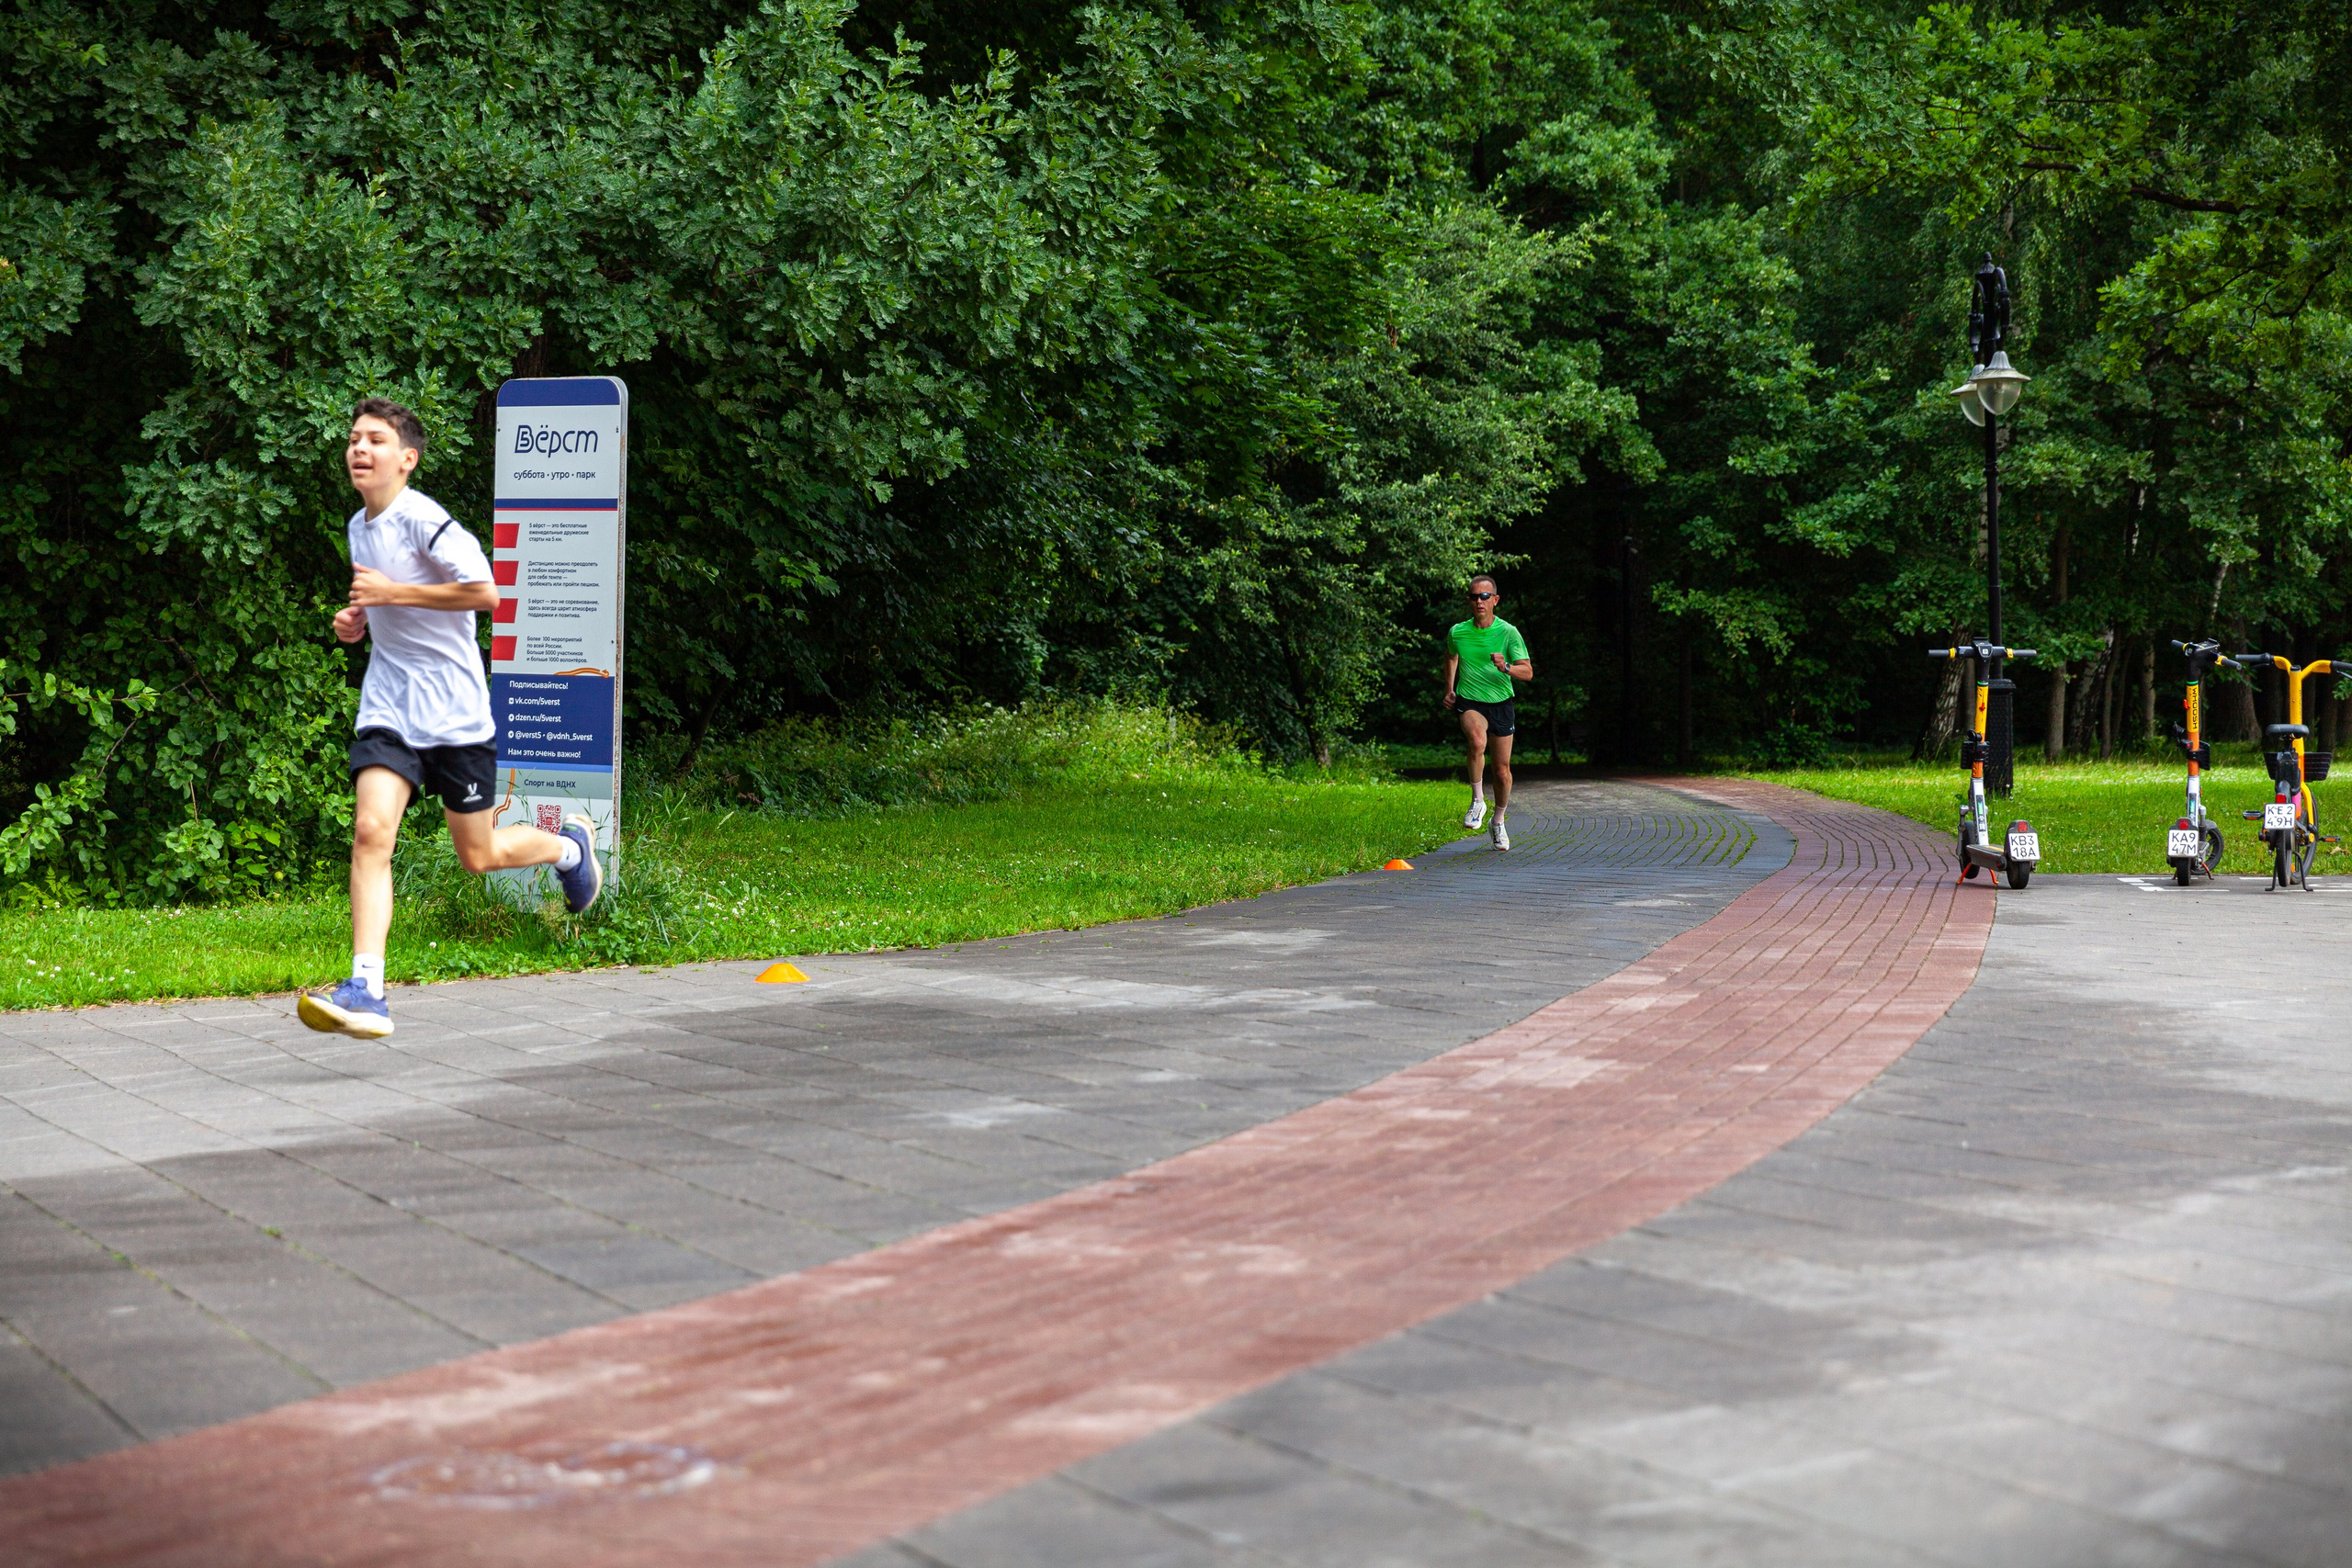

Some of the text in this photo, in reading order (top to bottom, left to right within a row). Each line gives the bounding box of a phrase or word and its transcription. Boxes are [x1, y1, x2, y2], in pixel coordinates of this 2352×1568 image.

[514, 470, 596, 480] суббота утро парк
[510, 680, 568, 689] Подписывайтесь!
[515, 696, 560, 705] vk.com/5verst
[515, 713, 561, 722] dzen.ru/5verst
[515, 731, 593, 741] @verst5 @vdnh_5verst
[524, 779, 544, 787] Спорт
[2011, 836, 2034, 846] KB3
[2172, 833, 2196, 842] KA9
[2013, 847, 2036, 857] 18A
[2172, 844, 2196, 854] 47M
